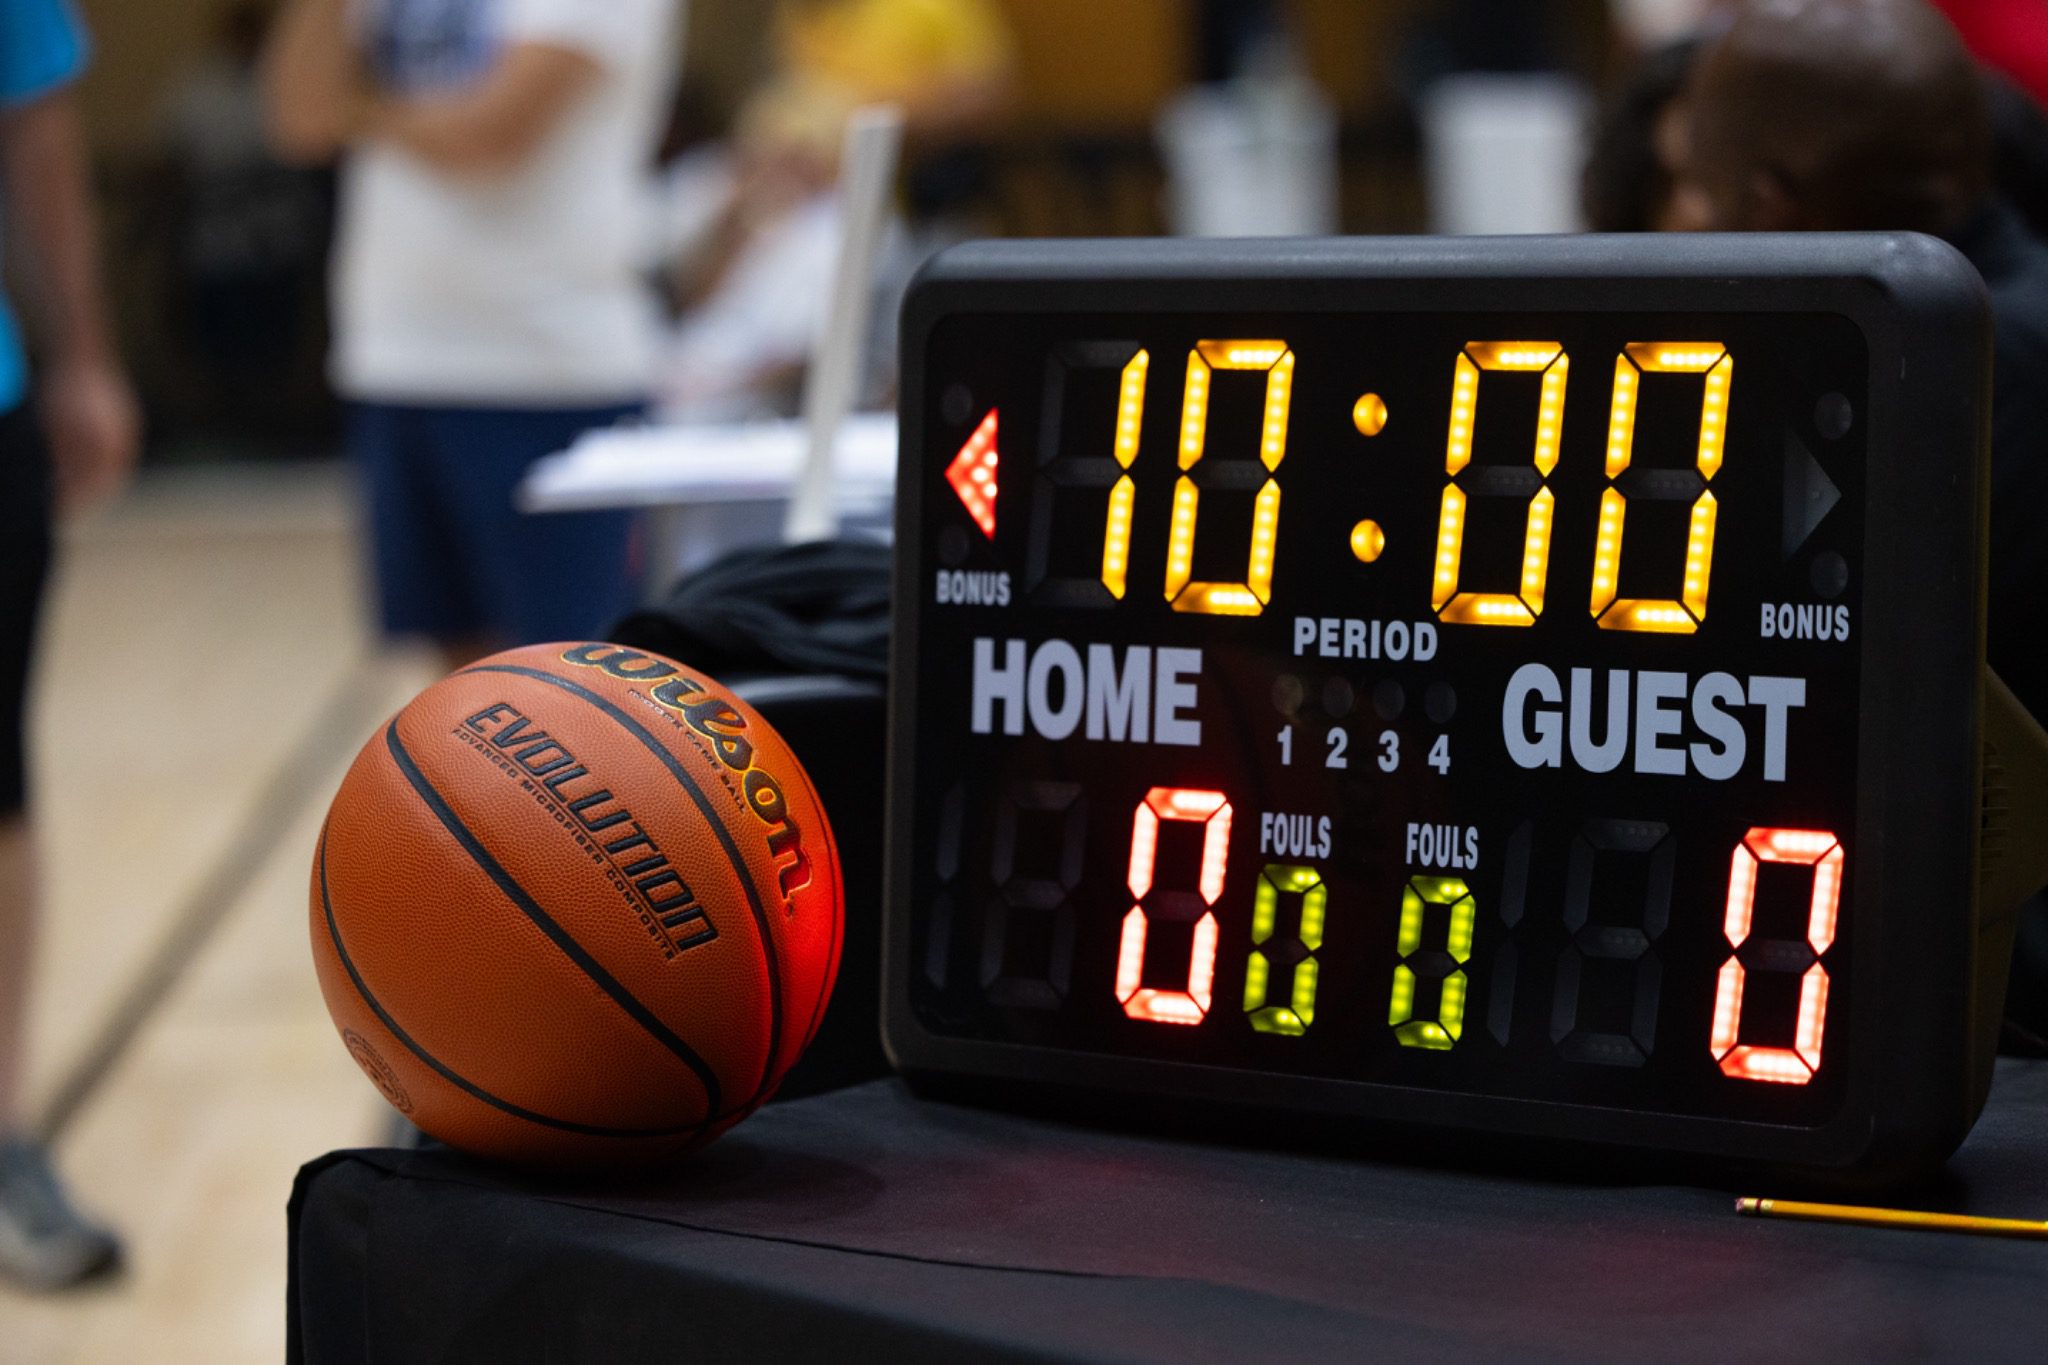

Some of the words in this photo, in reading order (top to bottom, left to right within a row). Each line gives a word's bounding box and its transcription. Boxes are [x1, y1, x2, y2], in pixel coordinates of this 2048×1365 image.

[1101, 339, 1734, 635] 10:00
[936, 570, 1011, 606] BONUS
[1294, 617, 1438, 662] PERIOD
[1760, 602, 1851, 641] BONUS
[971, 637, 1203, 746] HOME
[1277, 725, 1293, 766] 1
[1325, 726, 1349, 769] 2
[1377, 731, 1400, 773] 3
[1428, 734, 1451, 775] 4
[1502, 662, 1807, 782] GUEST
[452, 728, 519, 779] ADVANCED
[520, 778, 604, 865] MICROFIBER
[605, 868, 676, 961] COMPOSITE
[465, 702, 719, 951] EVOLUTION
[1260, 812, 1332, 859] FOULS
[1406, 823, 1478, 870] FOULS
[1115, 786, 1233, 1026] 0
[1243, 863, 1328, 1037] 0
[1388, 875, 1476, 1051] 0
[1711, 826, 1845, 1085] 0
